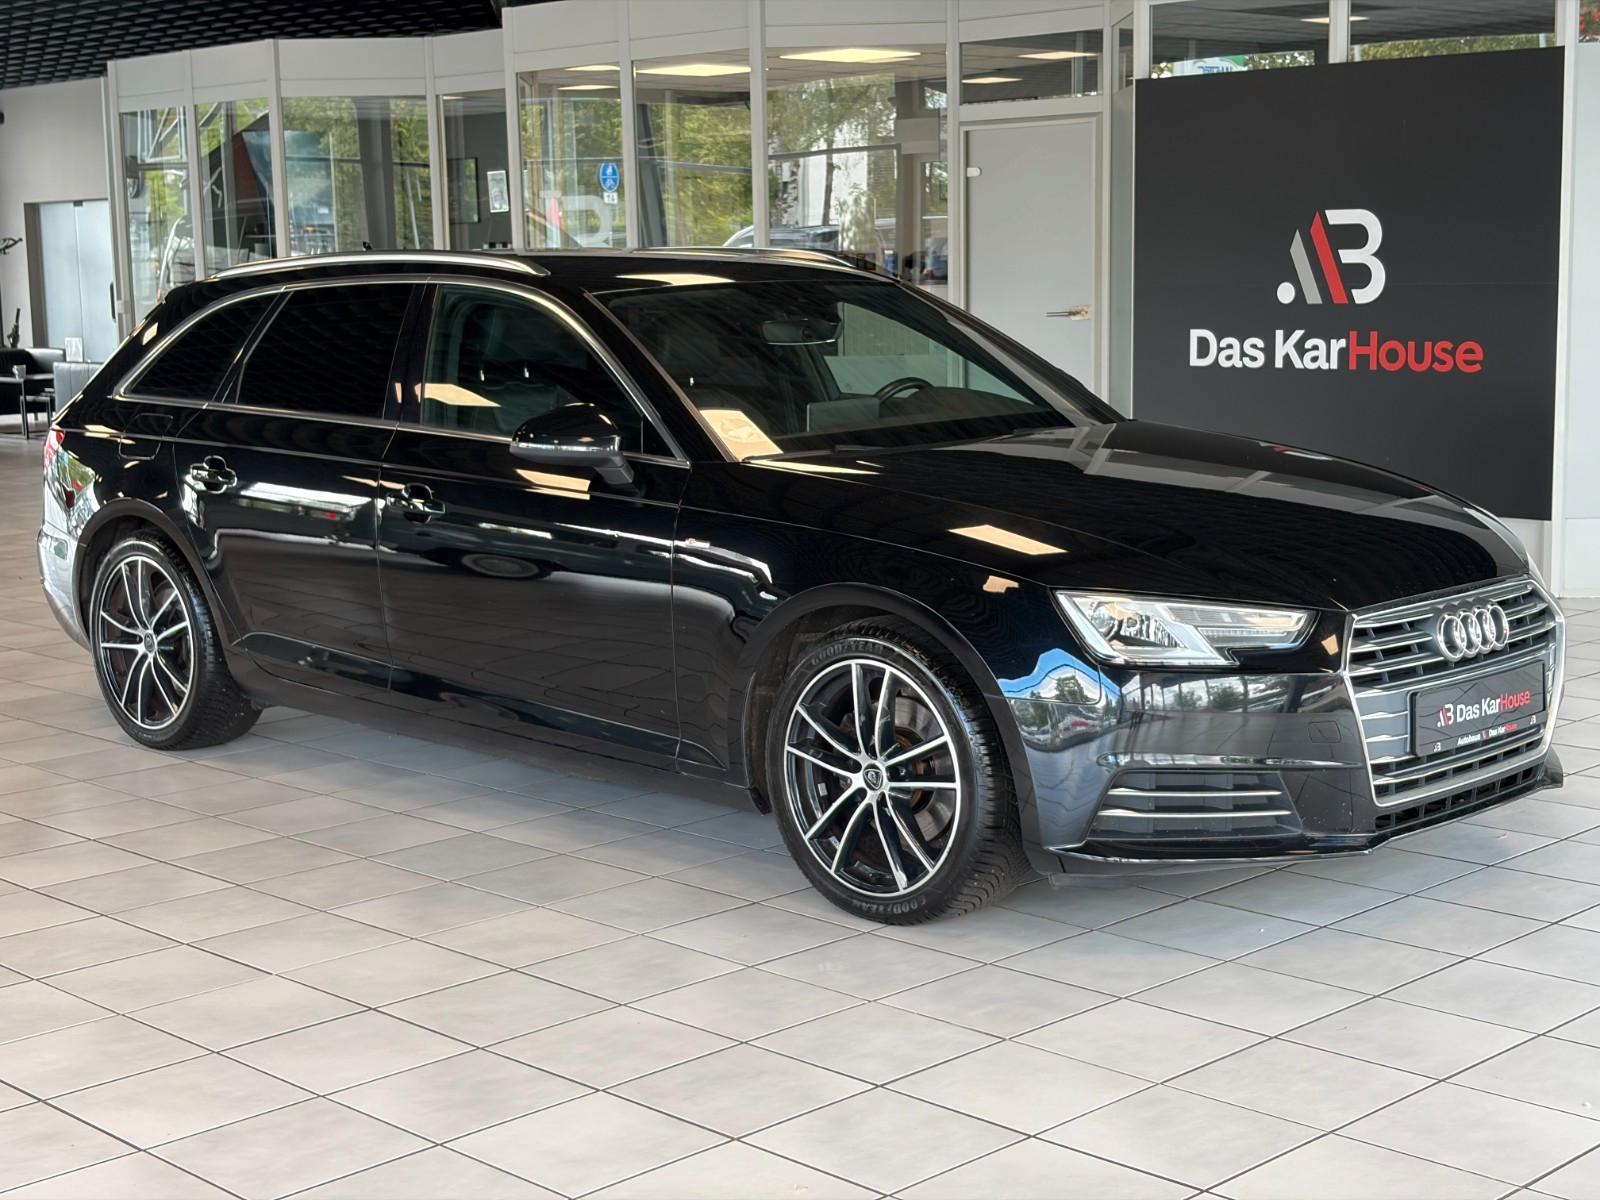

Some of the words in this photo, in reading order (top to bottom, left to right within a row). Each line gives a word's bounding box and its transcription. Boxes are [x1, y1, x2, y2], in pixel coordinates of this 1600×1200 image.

[1189, 328, 1265, 368] Das
[1275, 329, 1484, 373] KarHouse
[1456, 704, 1480, 722] Das
[1481, 690, 1530, 716] KarHouse
